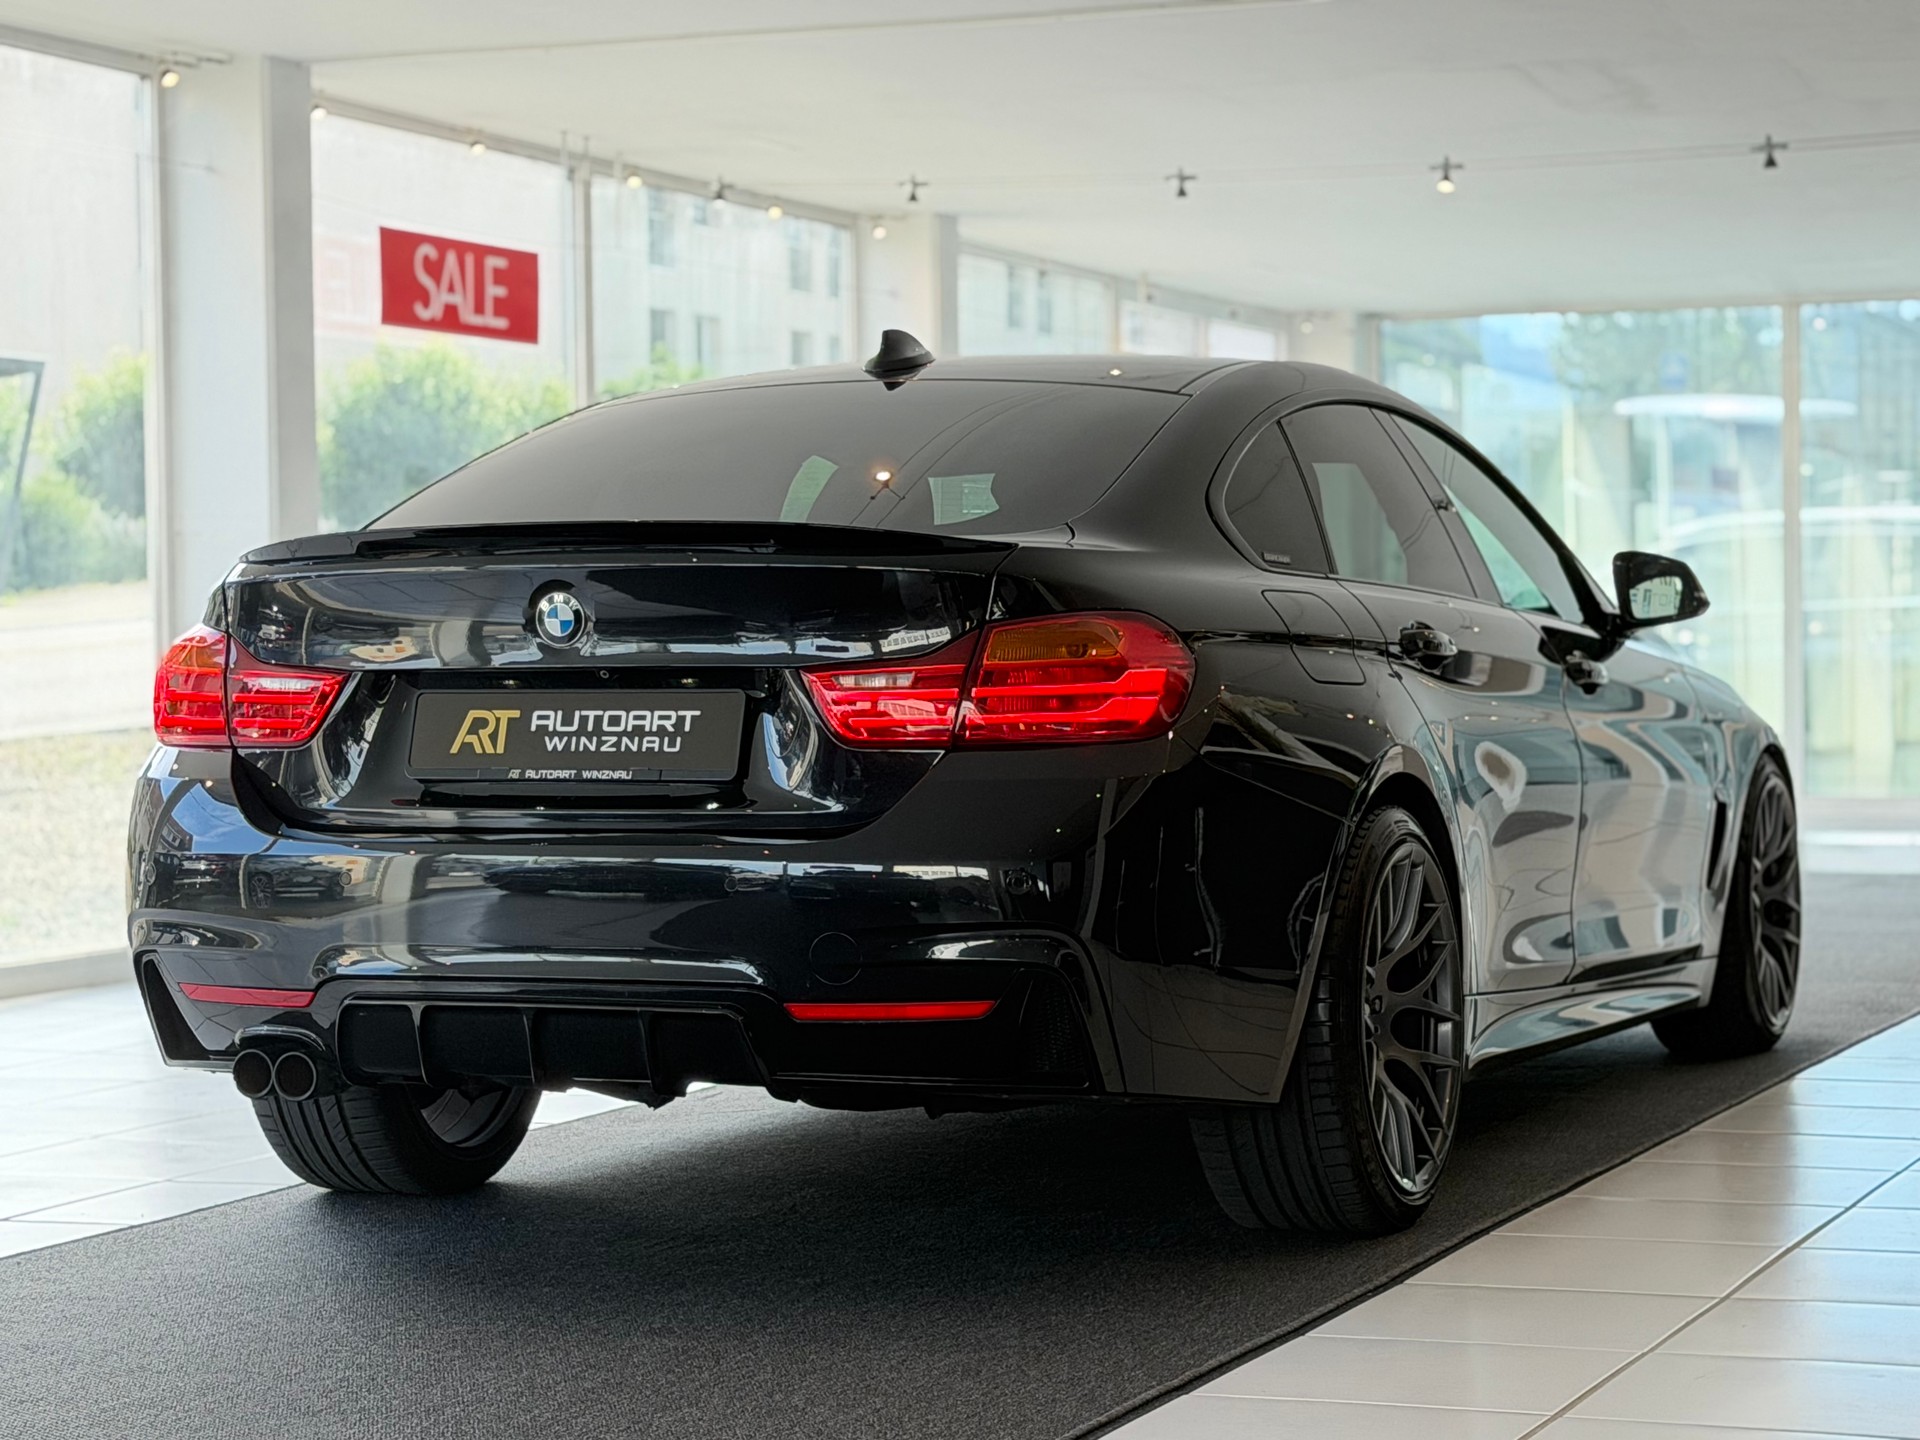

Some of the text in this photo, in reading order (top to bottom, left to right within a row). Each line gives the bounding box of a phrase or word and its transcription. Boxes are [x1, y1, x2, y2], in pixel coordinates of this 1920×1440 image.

[412, 242, 510, 330] SALE
[540, 594, 580, 612] BMW
[530, 710, 702, 732] AUTOART
[544, 736, 682, 752] WINZNAU
[525, 769, 577, 779] AUTOART
[582, 770, 633, 780] WINZNAU
